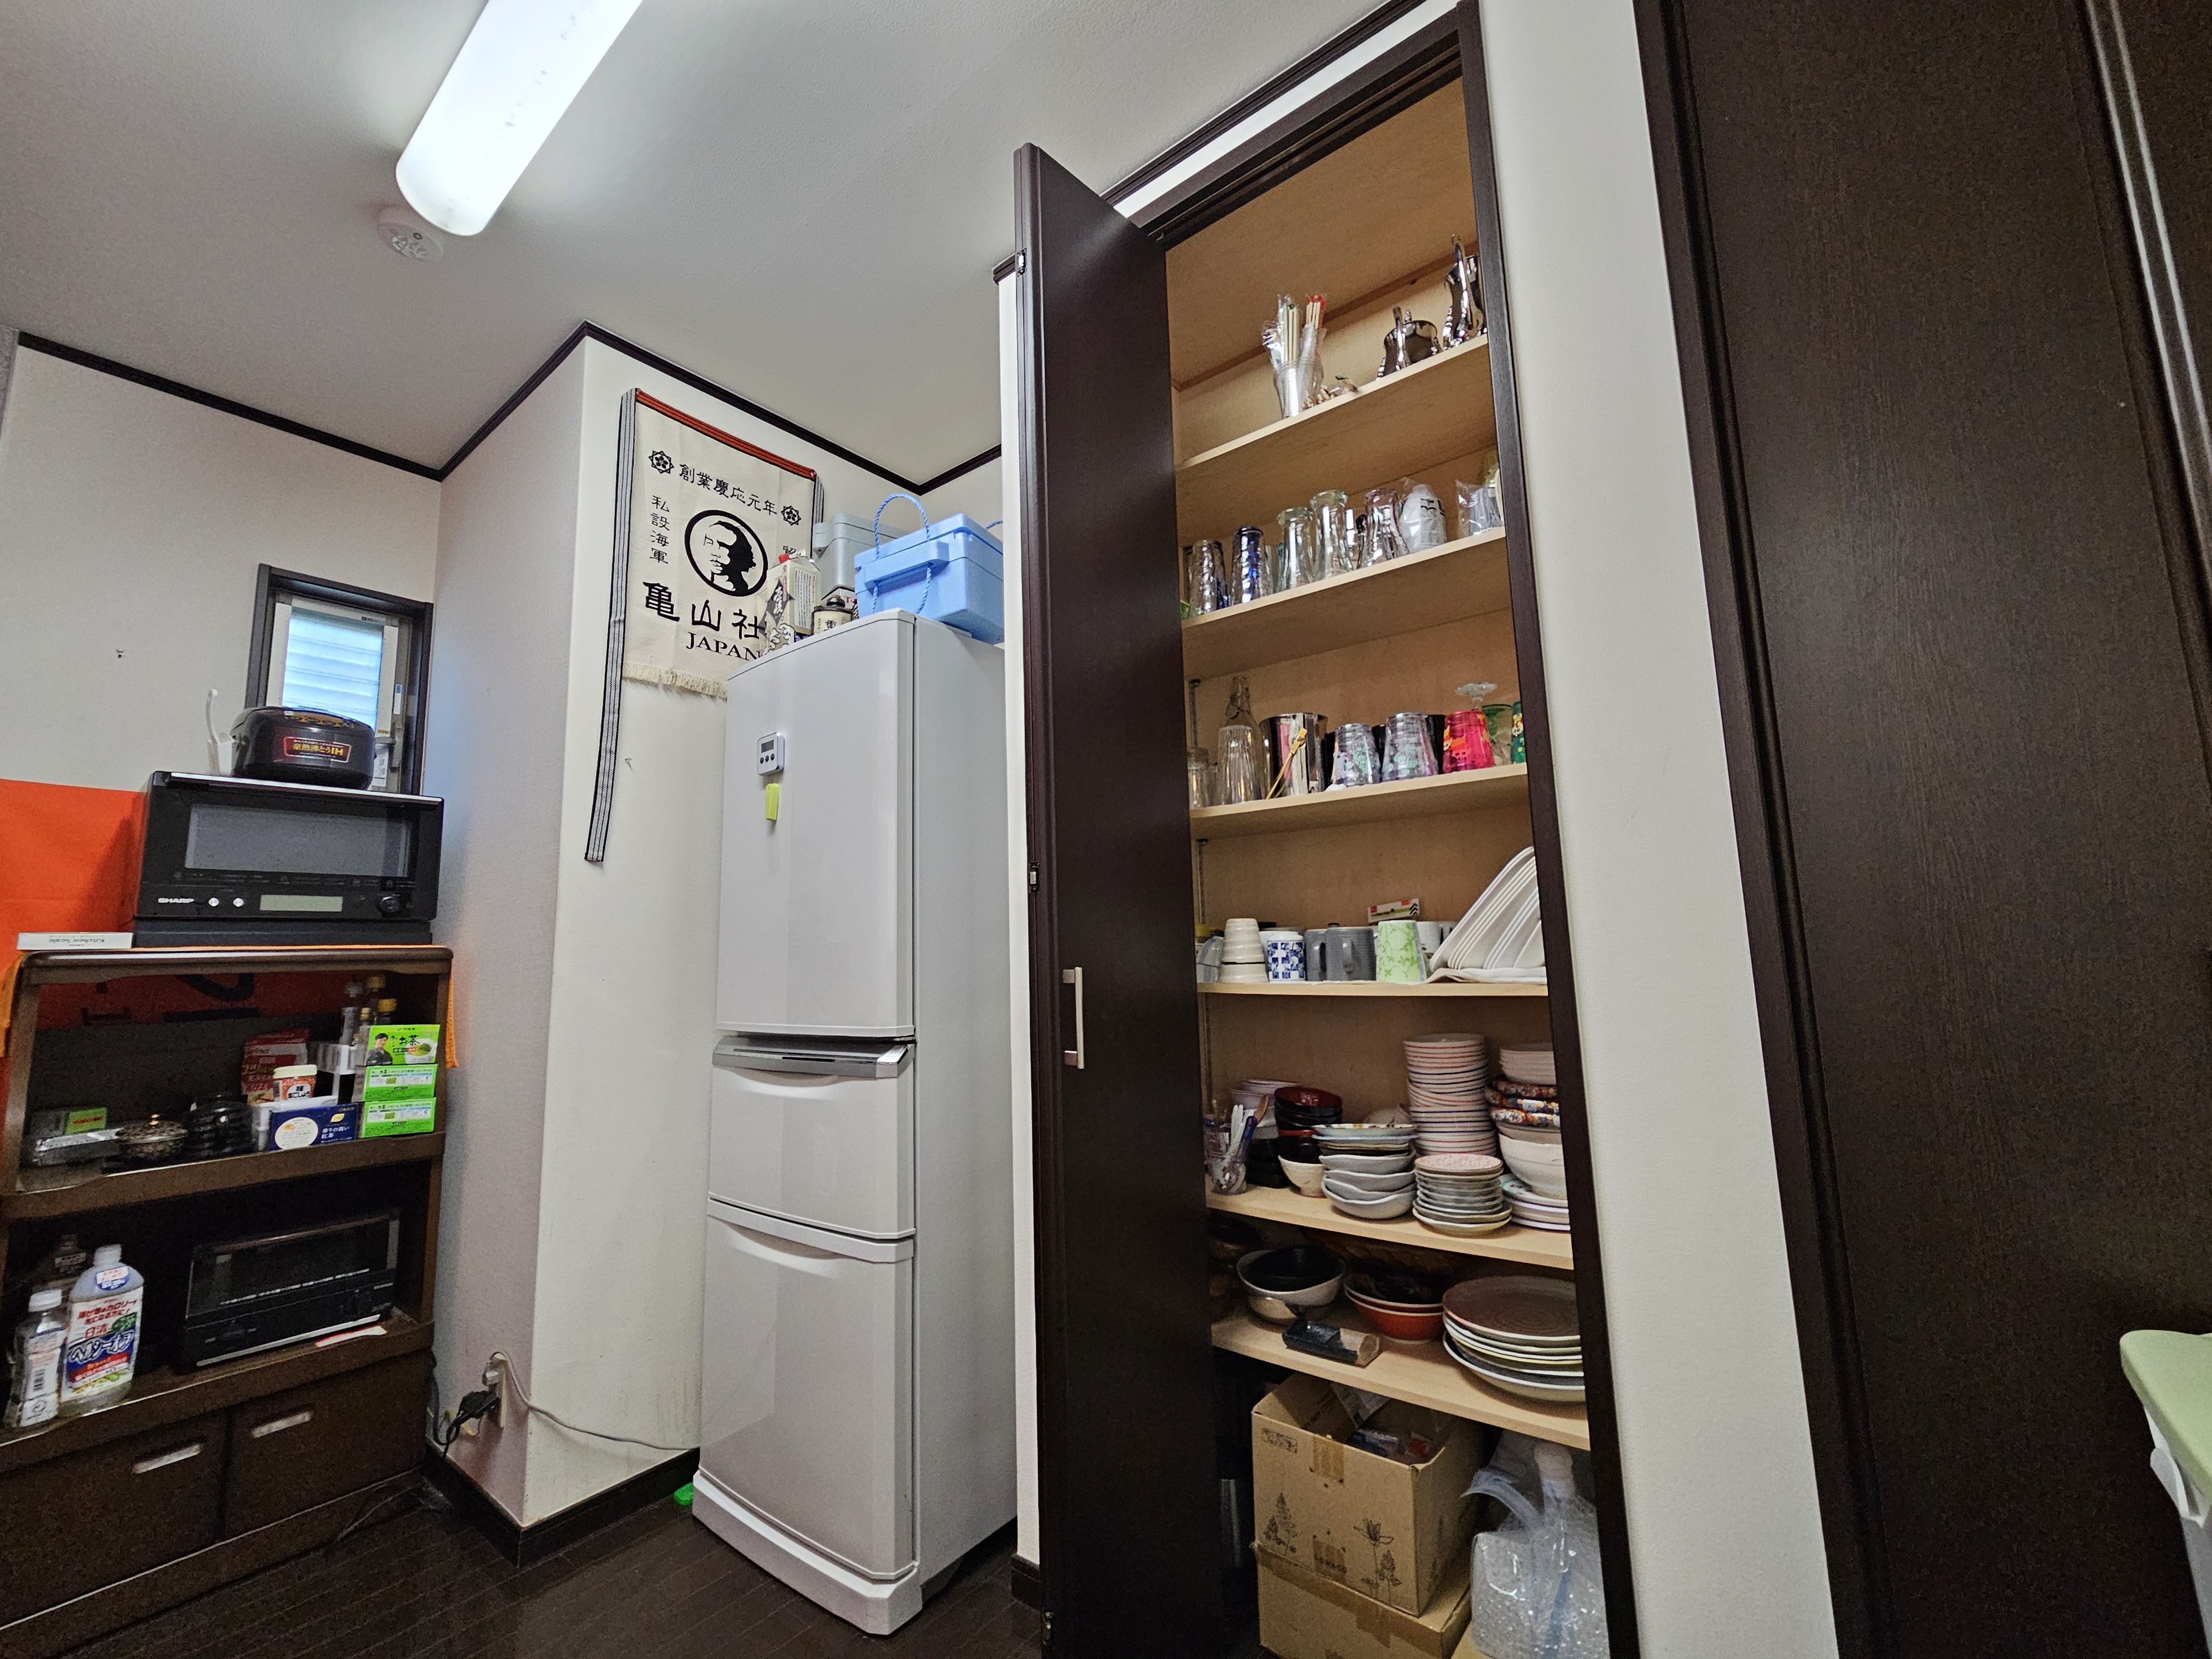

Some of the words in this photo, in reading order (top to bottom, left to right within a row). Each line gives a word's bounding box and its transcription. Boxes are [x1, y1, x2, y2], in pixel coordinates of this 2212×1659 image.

[679, 463, 777, 515] 創業慶応元年
[650, 495, 670, 565] 私設海軍
[686, 632, 761, 661] JAPAN
